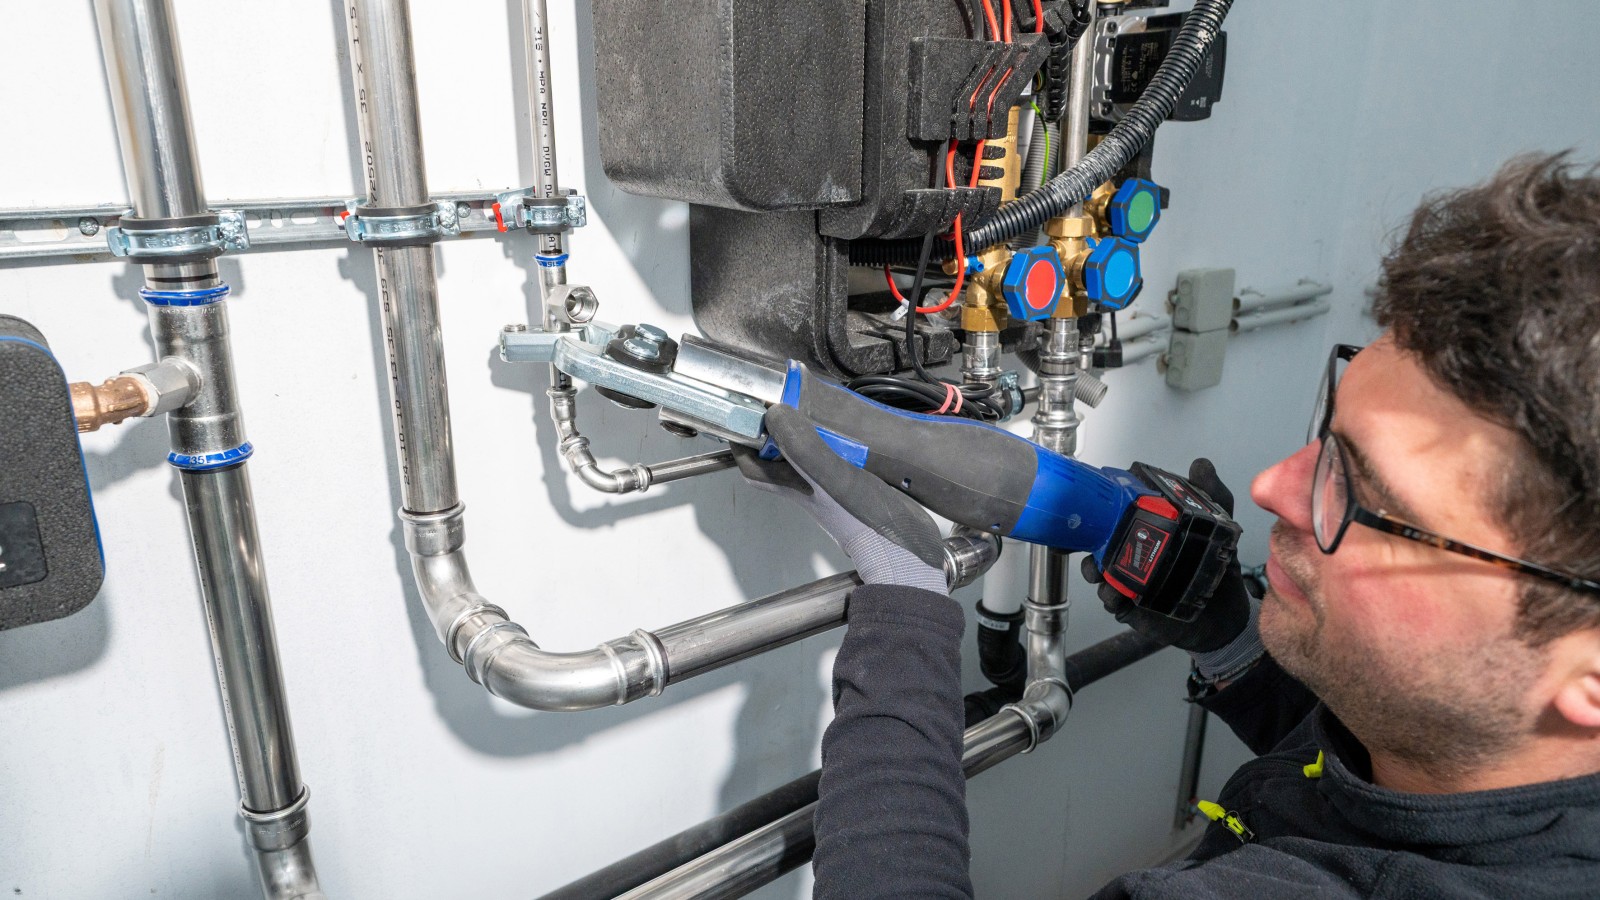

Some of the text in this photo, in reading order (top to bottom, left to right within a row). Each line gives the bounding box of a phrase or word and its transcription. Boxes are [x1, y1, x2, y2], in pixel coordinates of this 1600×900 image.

[359, 88, 367, 114] 35
[364, 140, 378, 208] 72502
[190, 455, 205, 465] 35
